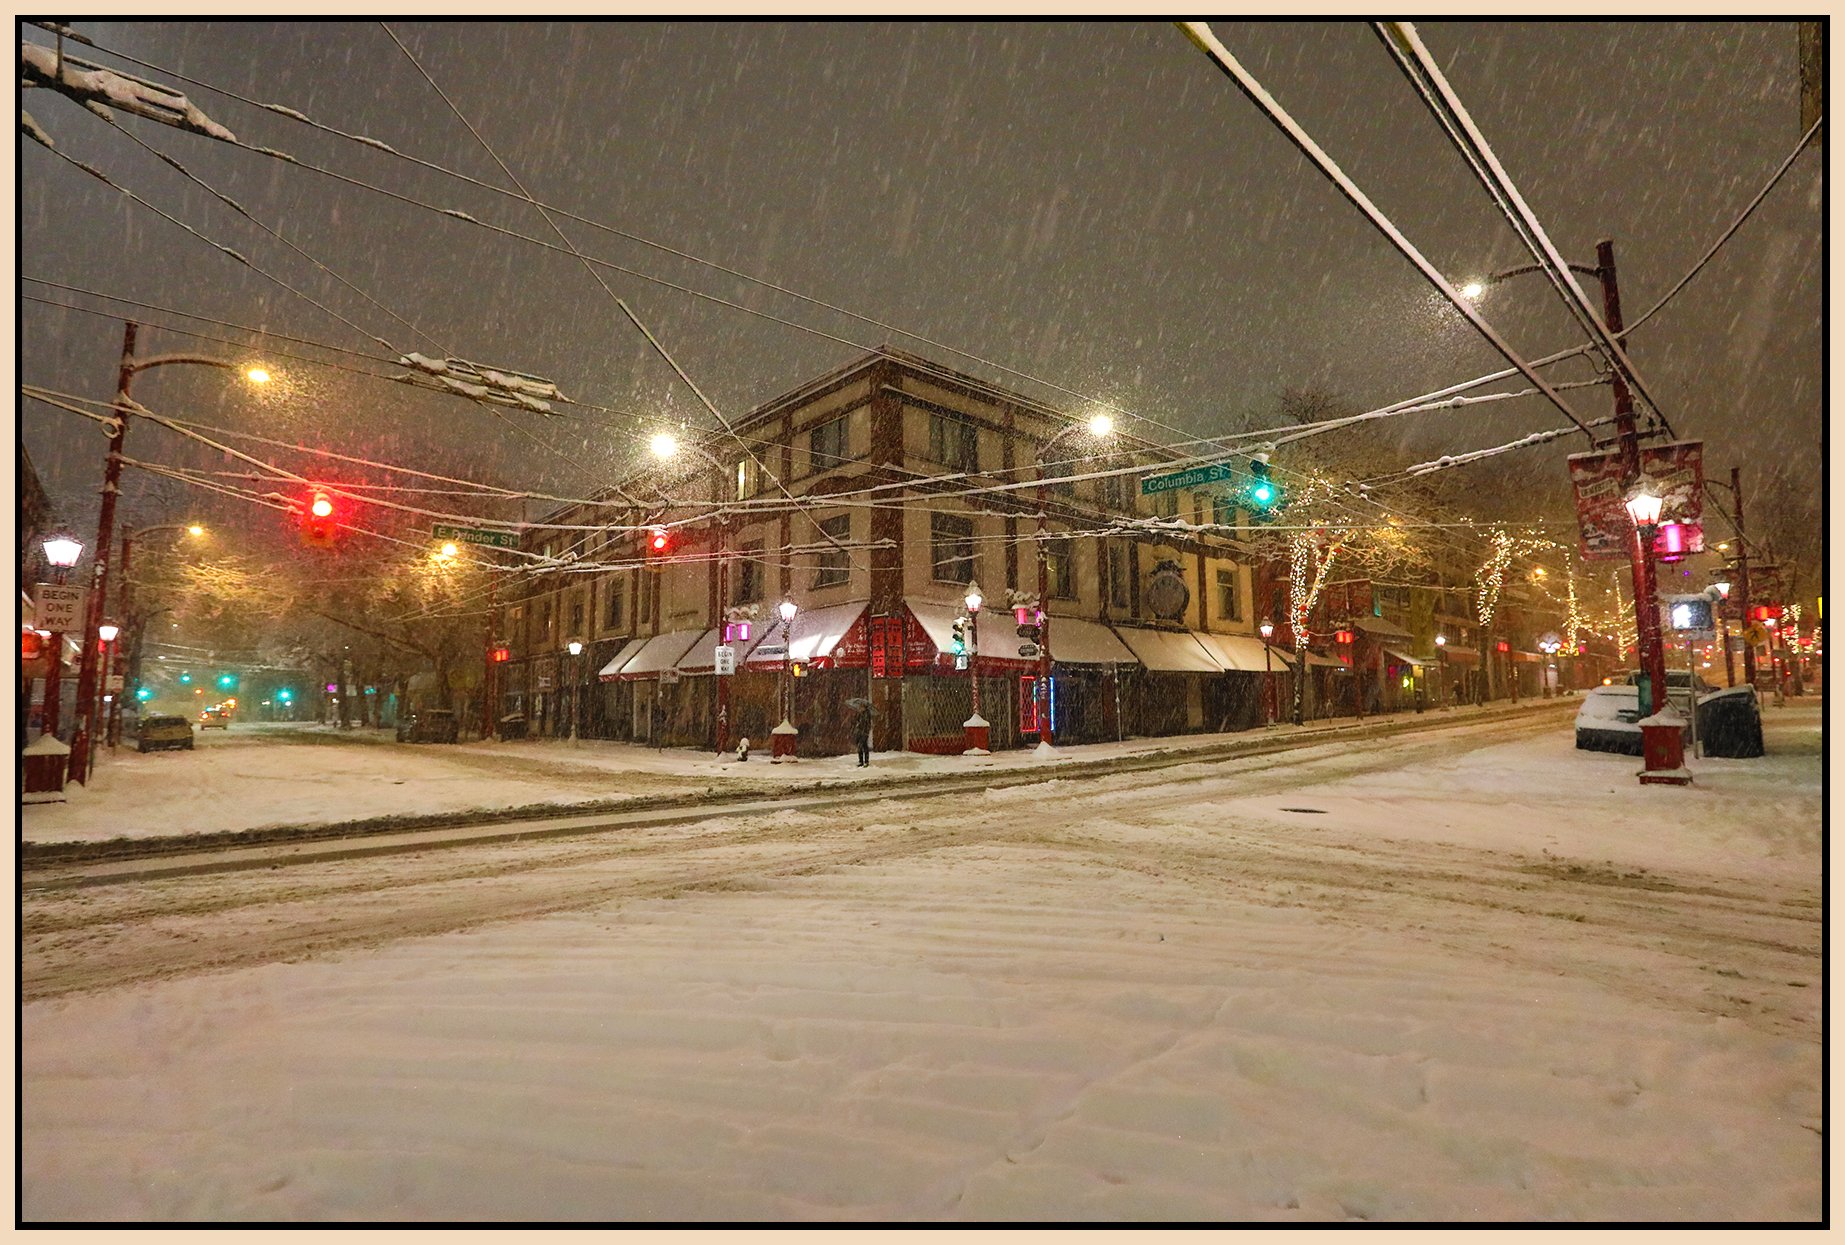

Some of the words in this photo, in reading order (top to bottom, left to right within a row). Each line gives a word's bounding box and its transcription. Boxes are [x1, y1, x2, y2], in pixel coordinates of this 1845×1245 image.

[1148, 473, 1204, 491] Columbia
[438, 527, 446, 538] E
[452, 529, 495, 544] Pender
[500, 535, 513, 546] St
[42, 589, 80, 600] BEGIN
[46, 602, 73, 613] ONE
[45, 616, 73, 626] WAY
